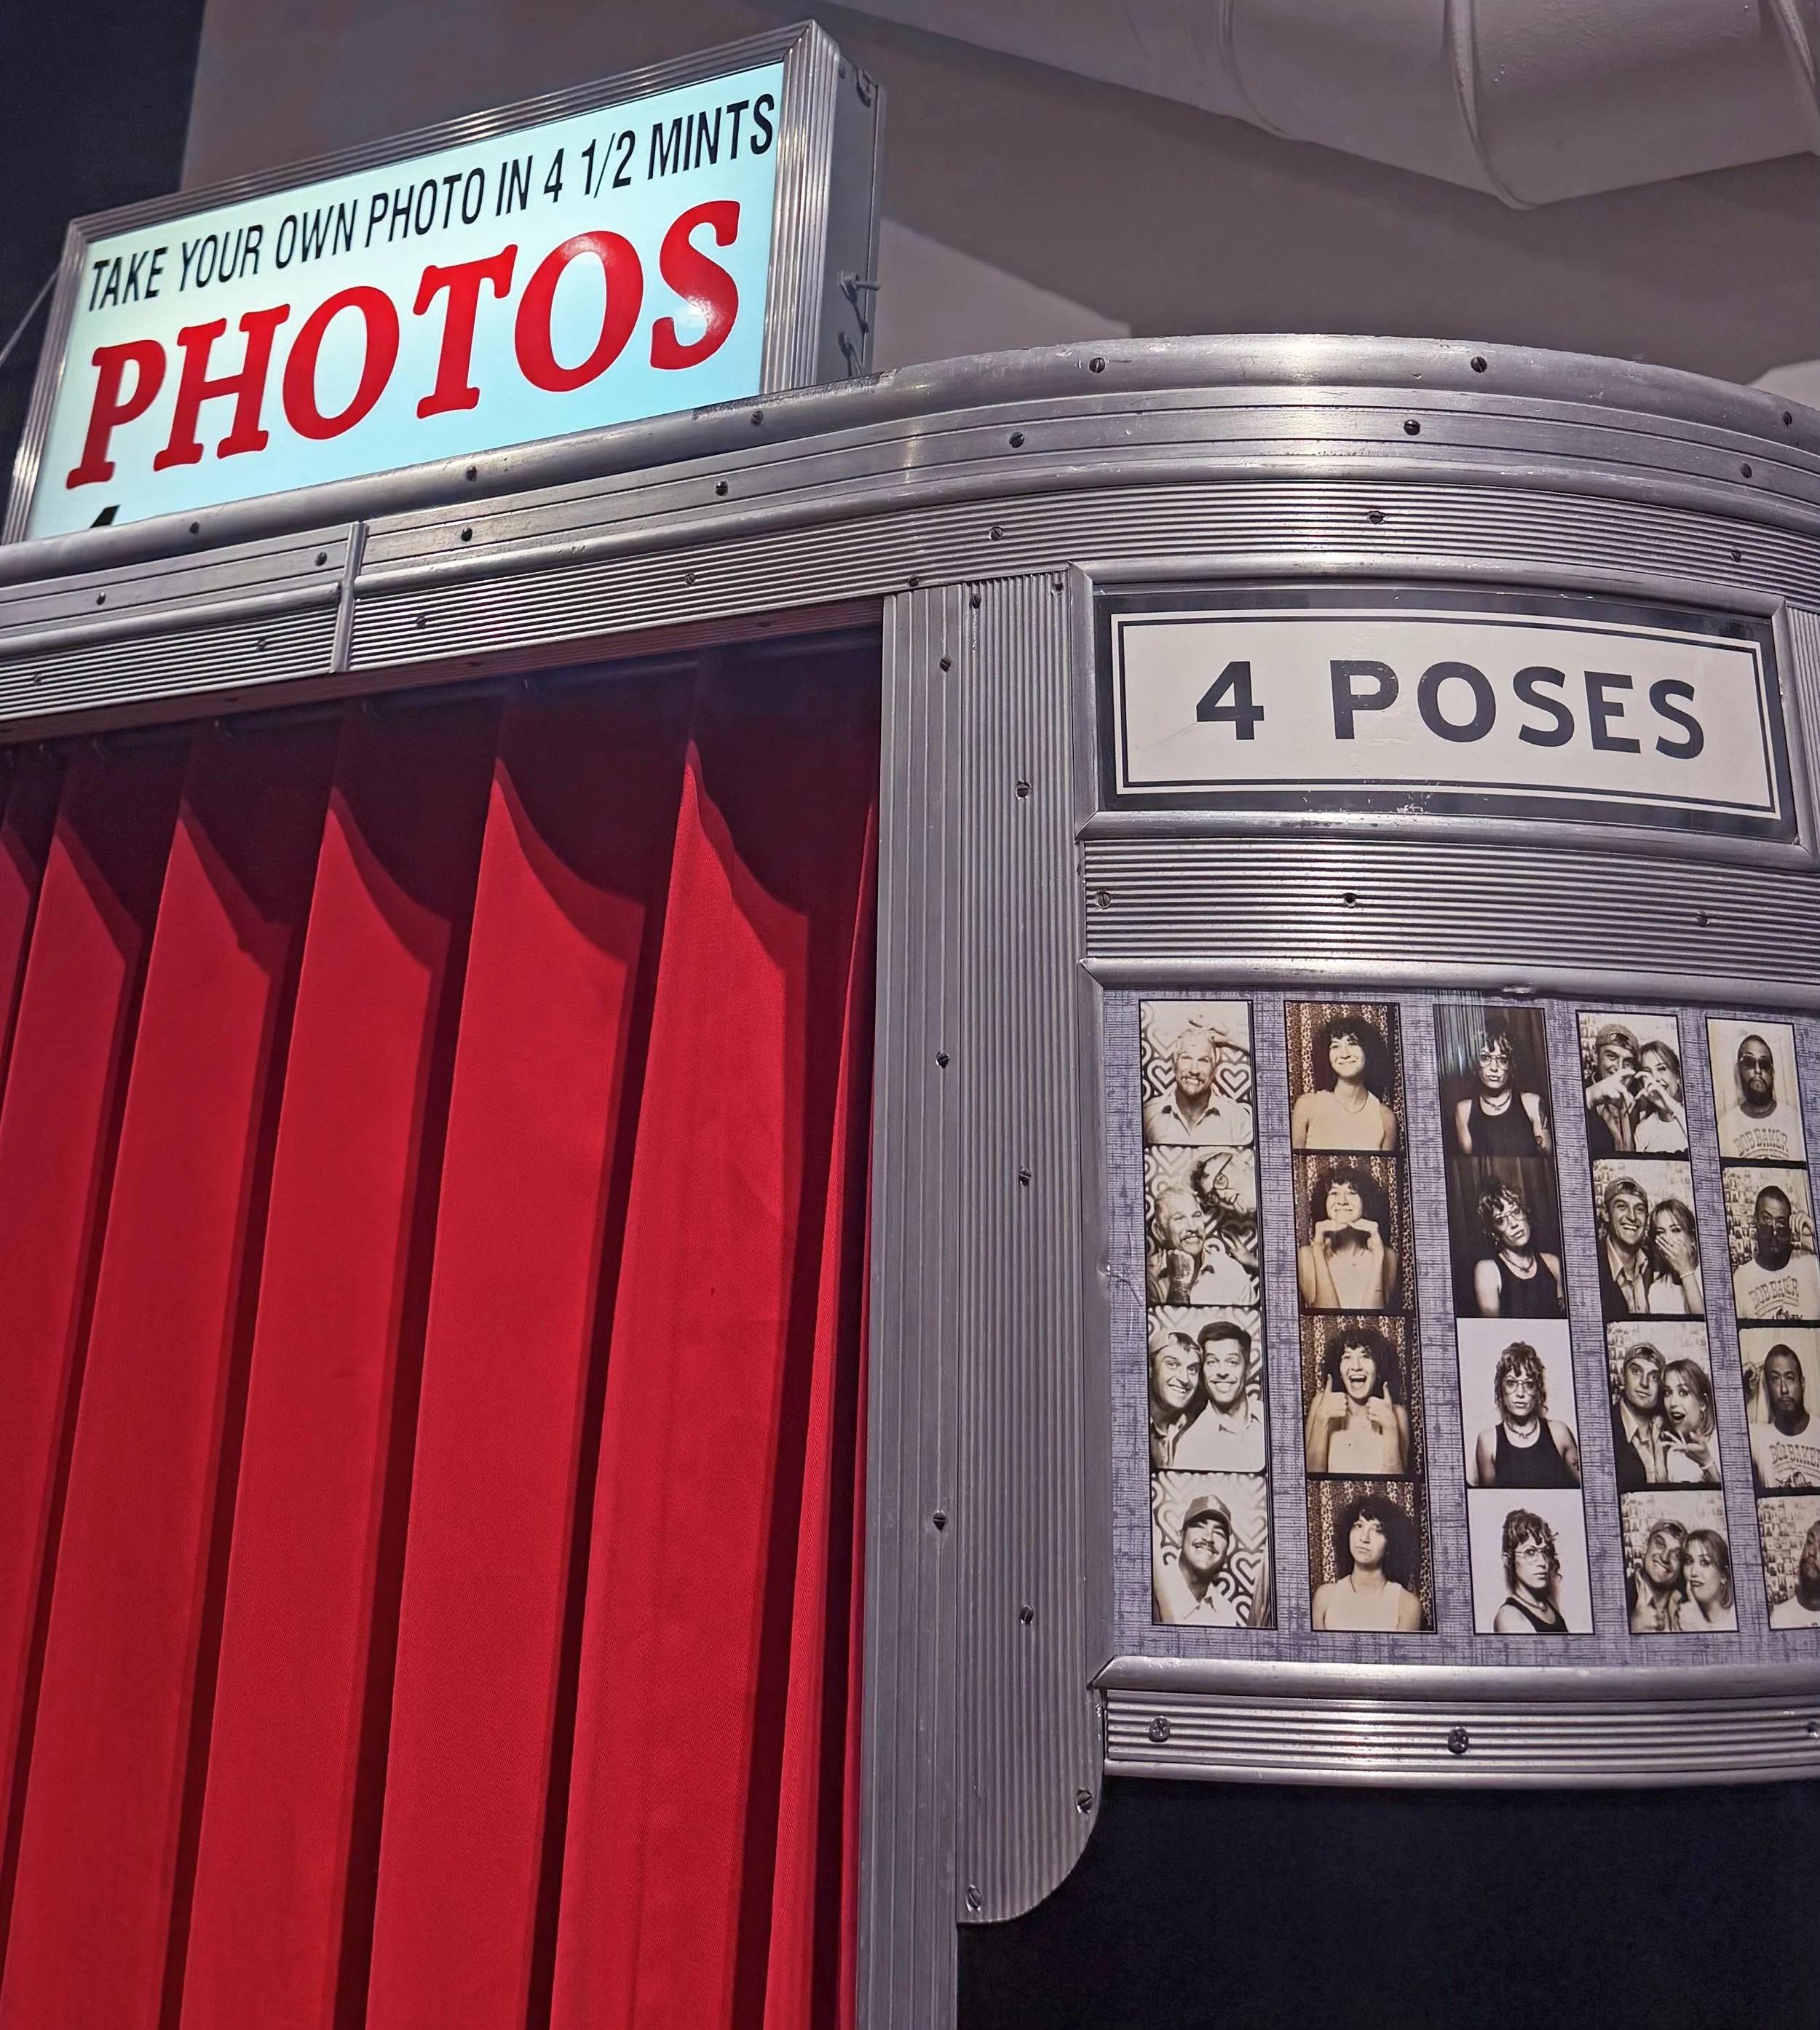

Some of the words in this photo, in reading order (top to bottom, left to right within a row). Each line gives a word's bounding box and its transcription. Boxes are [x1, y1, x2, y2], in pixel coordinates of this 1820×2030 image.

[88, 245, 168, 312] TAKE
[179, 223, 264, 293] YOUR
[275, 198, 358, 270] OWN
[365, 167, 485, 248] PHOTO
[495, 154, 534, 217] IN
[543, 148, 564, 204] 4
[581, 130, 636, 196] 1/2
[647, 93, 775, 181] MINTS
[66, 199, 740, 490] PHOTOS
[1195, 660, 1265, 740] 4
[1329, 659, 1704, 760] POSES
